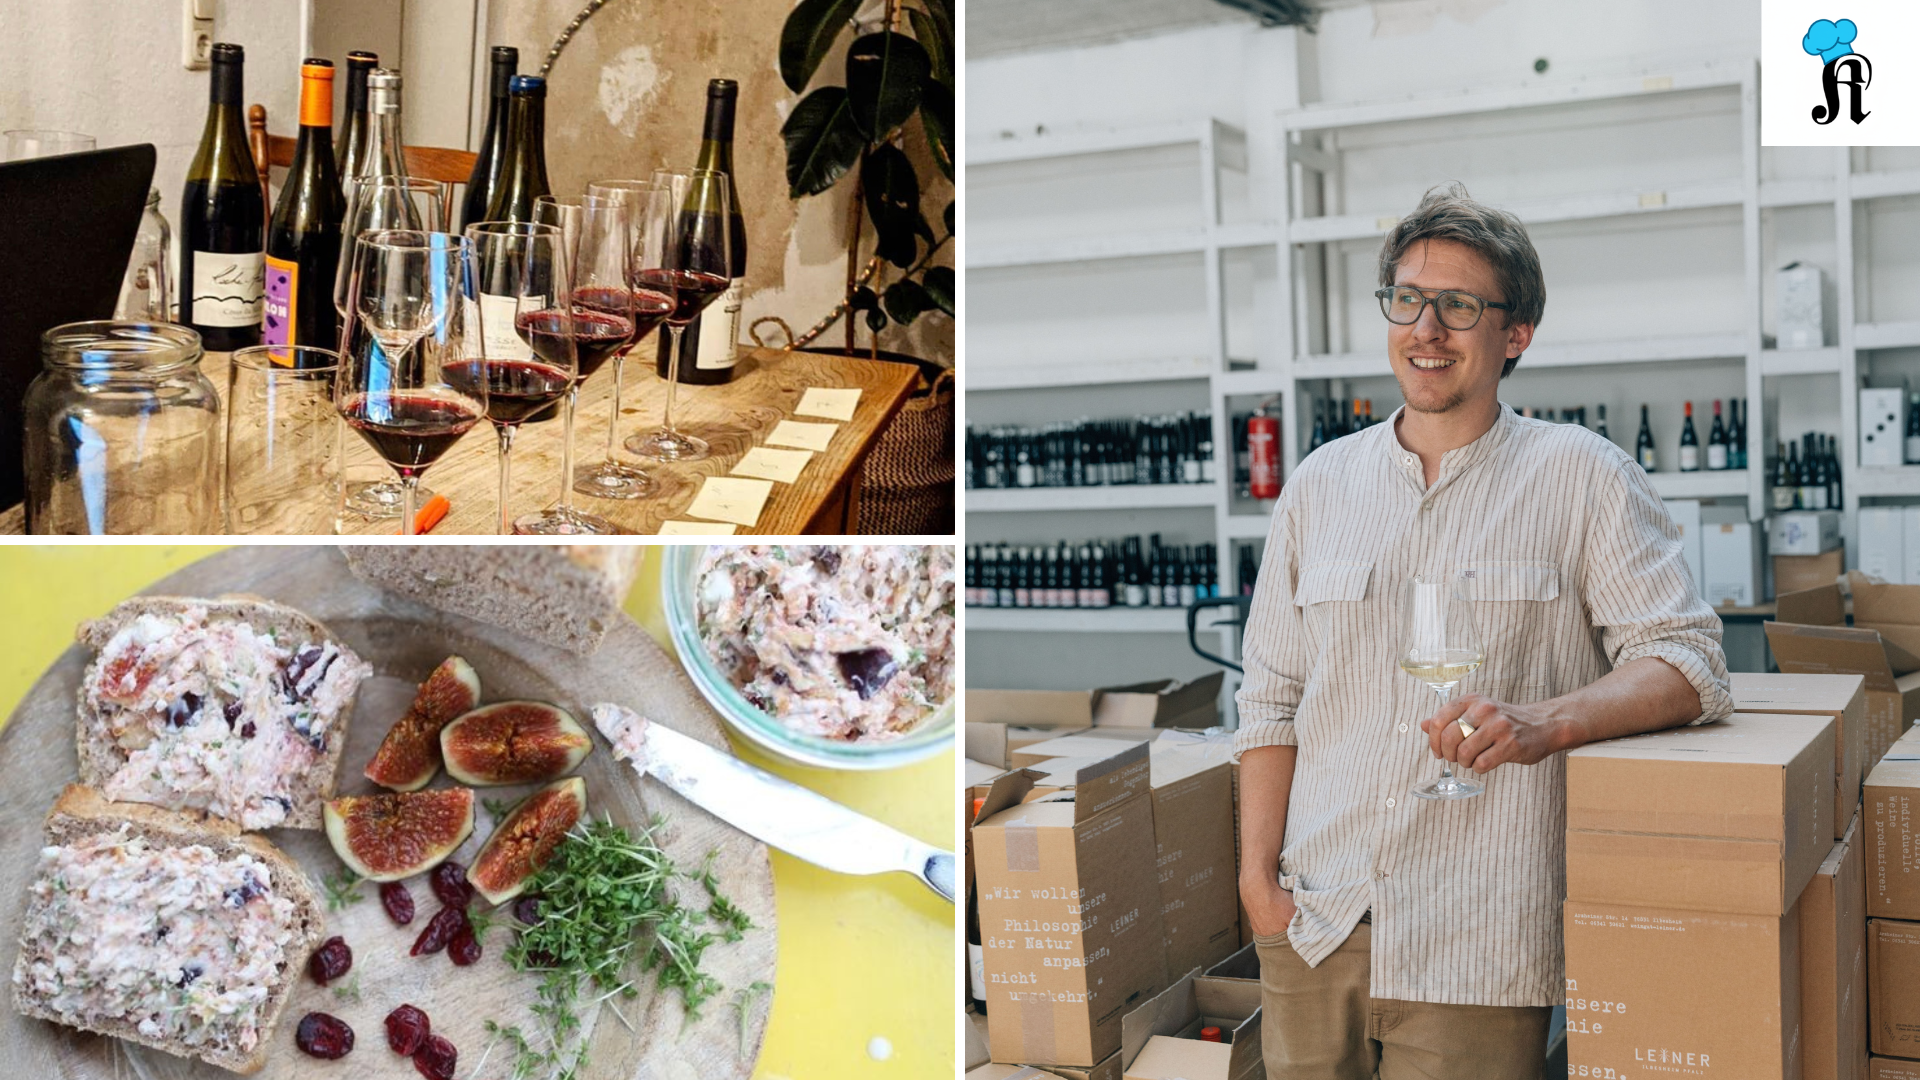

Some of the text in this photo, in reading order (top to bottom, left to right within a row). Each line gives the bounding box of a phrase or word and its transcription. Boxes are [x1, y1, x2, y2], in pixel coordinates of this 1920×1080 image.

[1876, 802, 1884, 815] zu
[1889, 795, 1897, 828] Weine
[1901, 796, 1911, 873] individuelle
[1030, 887, 1086, 900] wollen
[1067, 892, 1106, 914] unsere
[1004, 915, 1098, 935] Philosophie
[1110, 908, 1139, 933] LEINER
[988, 936, 1073, 949] der Natur
[991, 972, 1038, 984] nicht
[1635, 1048, 1710, 1067] LEINER
